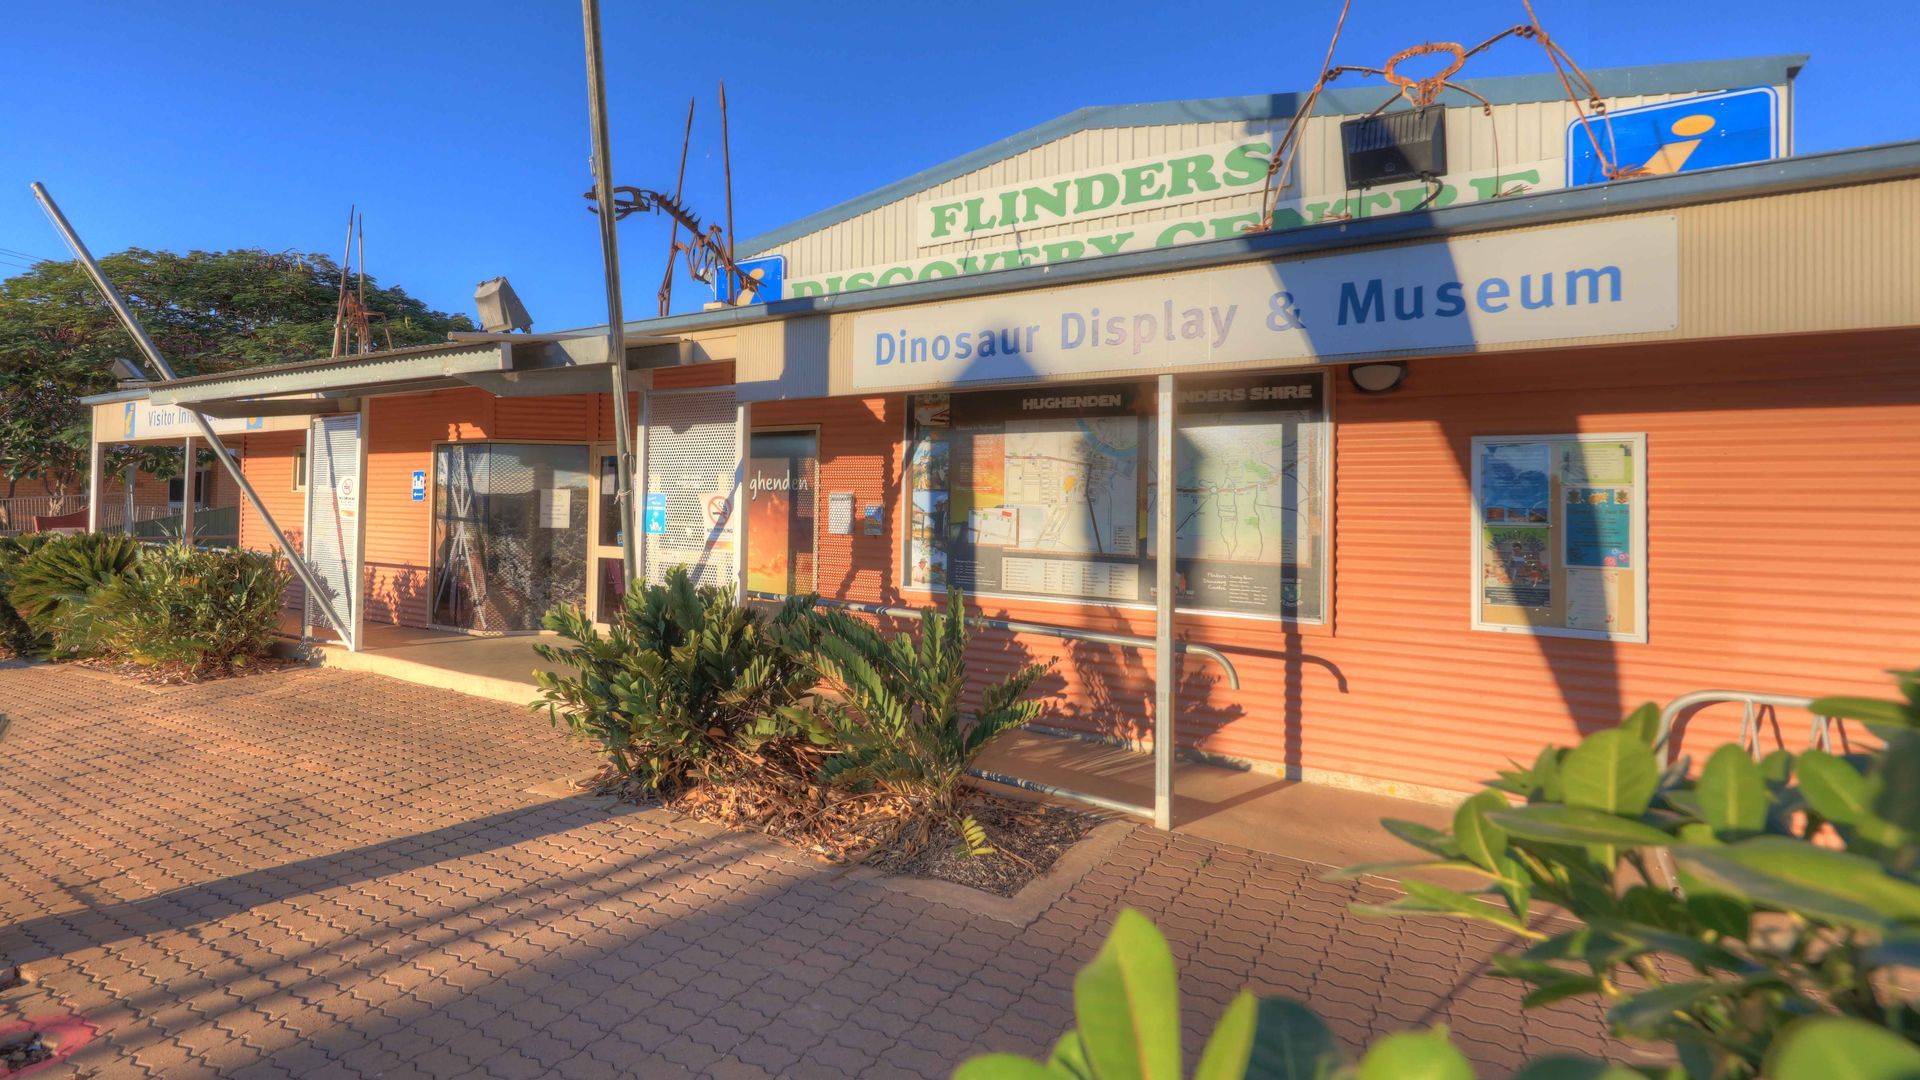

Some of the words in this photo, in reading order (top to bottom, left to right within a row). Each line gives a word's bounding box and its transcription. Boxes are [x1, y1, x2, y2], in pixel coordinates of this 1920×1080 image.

[930, 142, 1272, 239] FLINDERS
[875, 324, 1041, 366] Dinosaur
[1060, 299, 1239, 355] Display
[1265, 291, 1307, 332] &
[1337, 265, 1622, 326] Museum
[1250, 385, 1313, 400] SHIRE
[1022, 394, 1121, 409] HUGHENDEN
[148, 410, 175, 426] Visitor
